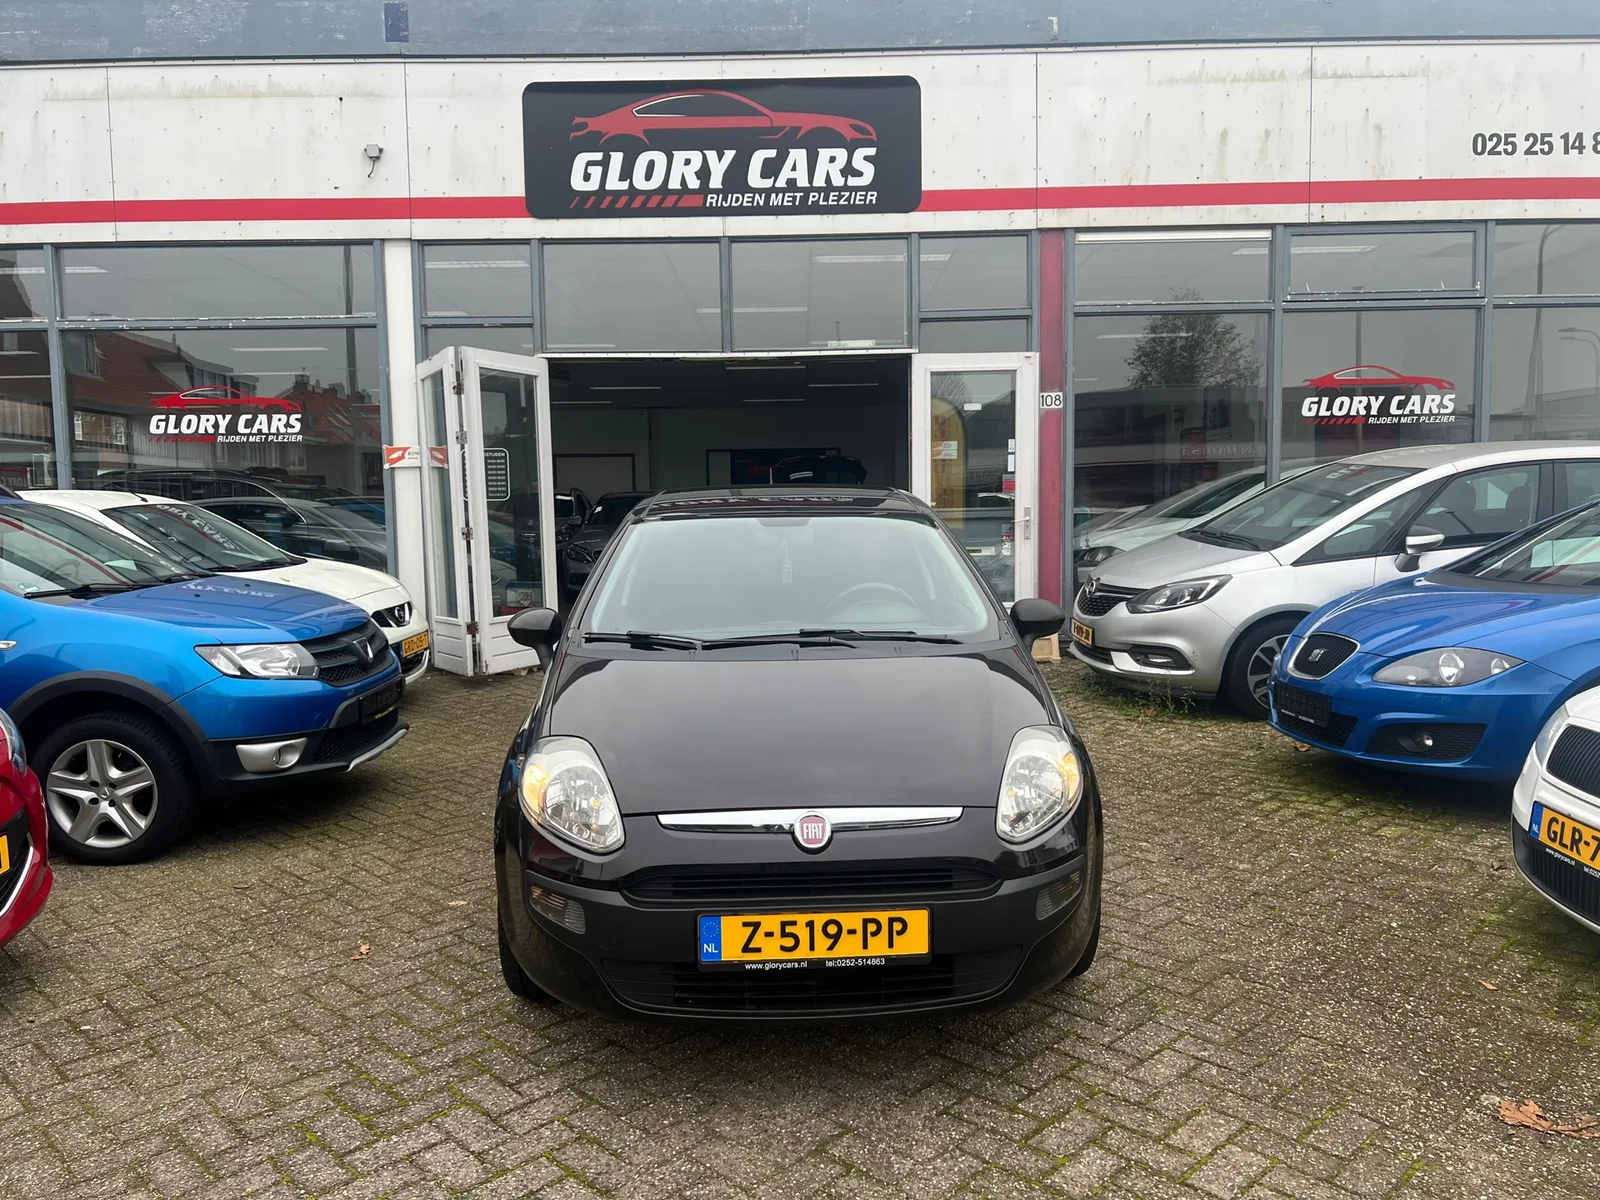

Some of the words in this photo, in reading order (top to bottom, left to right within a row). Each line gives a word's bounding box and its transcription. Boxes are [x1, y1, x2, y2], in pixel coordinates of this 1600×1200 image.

[1472, 133, 1517, 156] 025
[1524, 133, 1554, 156] 25
[1560, 132, 1586, 155] 14
[570, 150, 737, 192] GLORY
[746, 147, 877, 189] CARS
[706, 194, 767, 208] RIJDEN
[769, 193, 804, 206] MET
[807, 192, 877, 206] PLEZIER
[1041, 394, 1062, 407] 108
[1301, 395, 1386, 417] GLORY
[1389, 394, 1456, 415] CARS
[150, 414, 232, 434] GLORY
[237, 414, 302, 434] CARS
[1400, 416, 1417, 424] MET
[217, 435, 247, 443] RIJDEN
[803, 822, 824, 839] FIAT
[1532, 823, 1539, 834] NL
[740, 916, 909, 954] Z-519-PP
[703, 943, 718, 954] NL
[745, 960, 808, 970] www.glorycars.nl
[825, 958, 885, 967] tel:0252-514863
